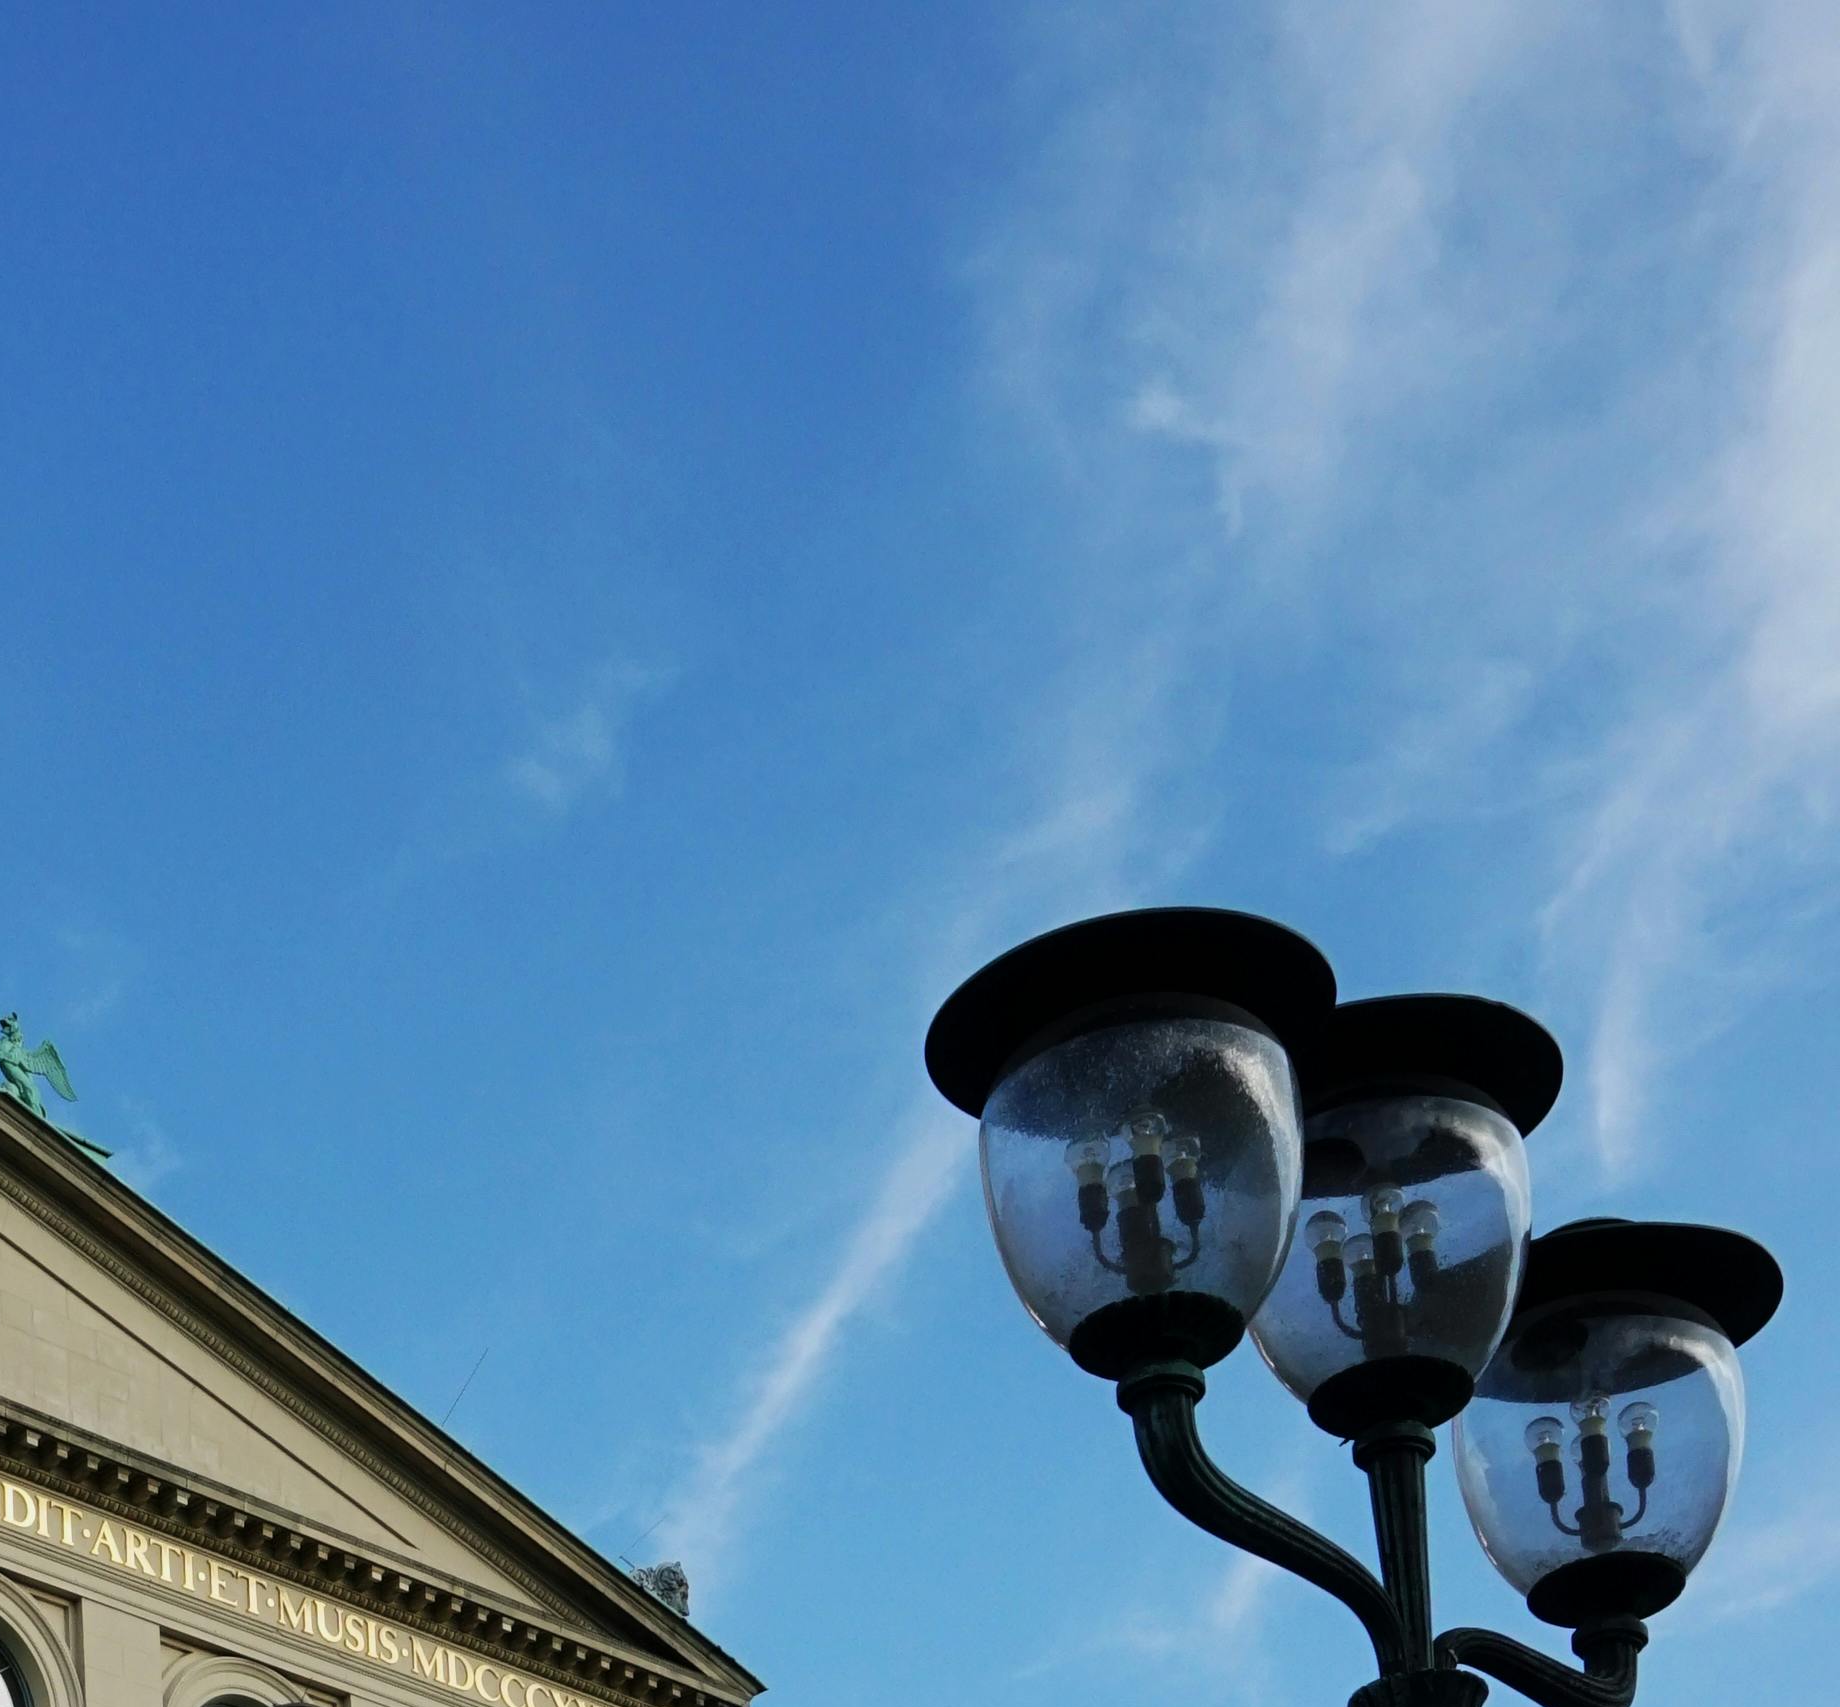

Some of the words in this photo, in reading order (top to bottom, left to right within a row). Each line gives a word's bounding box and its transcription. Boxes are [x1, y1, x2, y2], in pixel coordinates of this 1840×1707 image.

[90, 1518, 196, 1593] ARTI
[208, 1559, 269, 1616] ET
[276, 1585, 401, 1667] MUSIS
